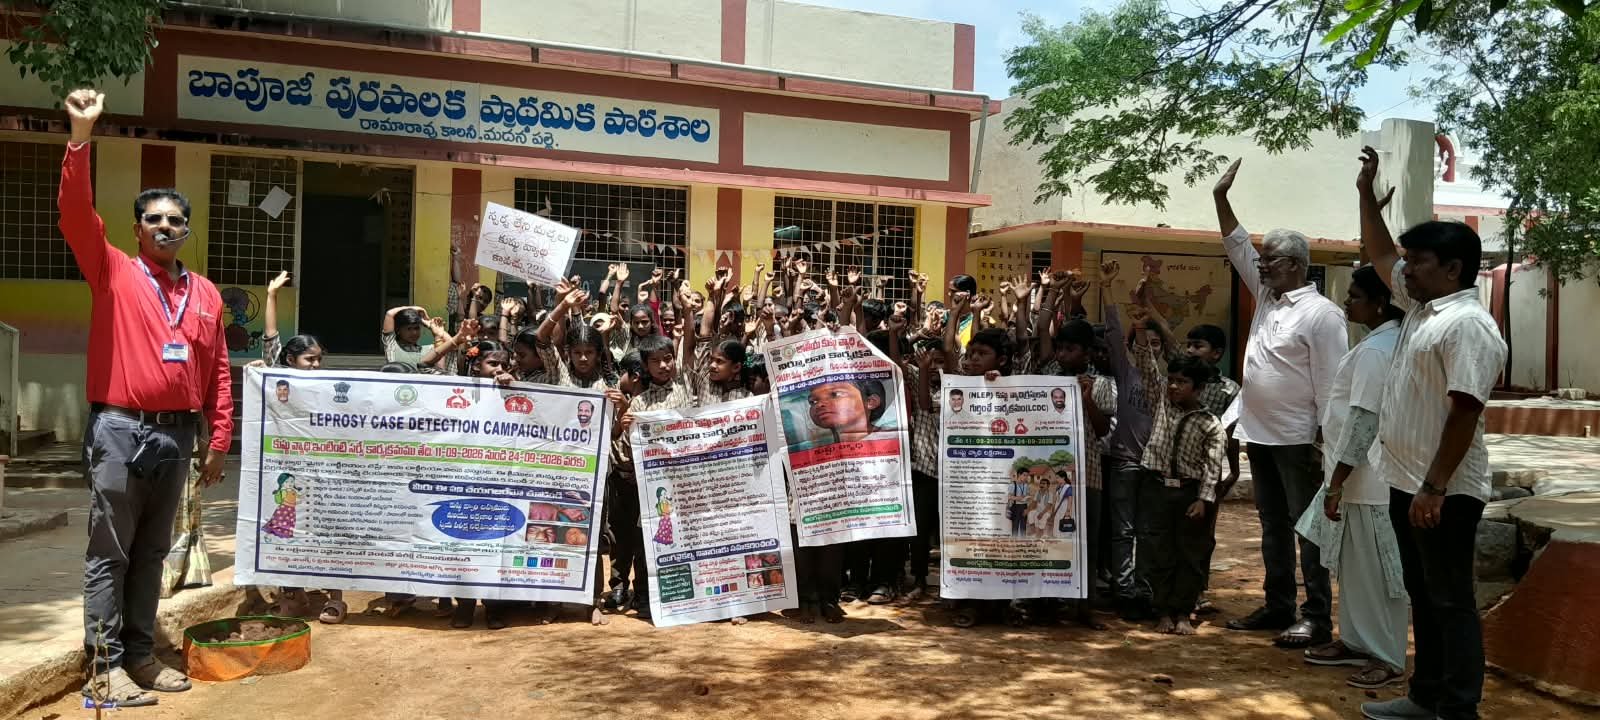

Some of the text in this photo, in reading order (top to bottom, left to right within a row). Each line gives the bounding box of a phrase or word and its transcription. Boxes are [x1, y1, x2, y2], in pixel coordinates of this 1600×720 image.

[188, 67, 711, 143] బాపూజీ పురపాలక ప్రాథమిక పాఠశాల
[360, 118, 438, 139] రామారావు
[310, 412, 592, 444] LEPROSY CASE DETECTION CAMPAIGN (LCDC)
